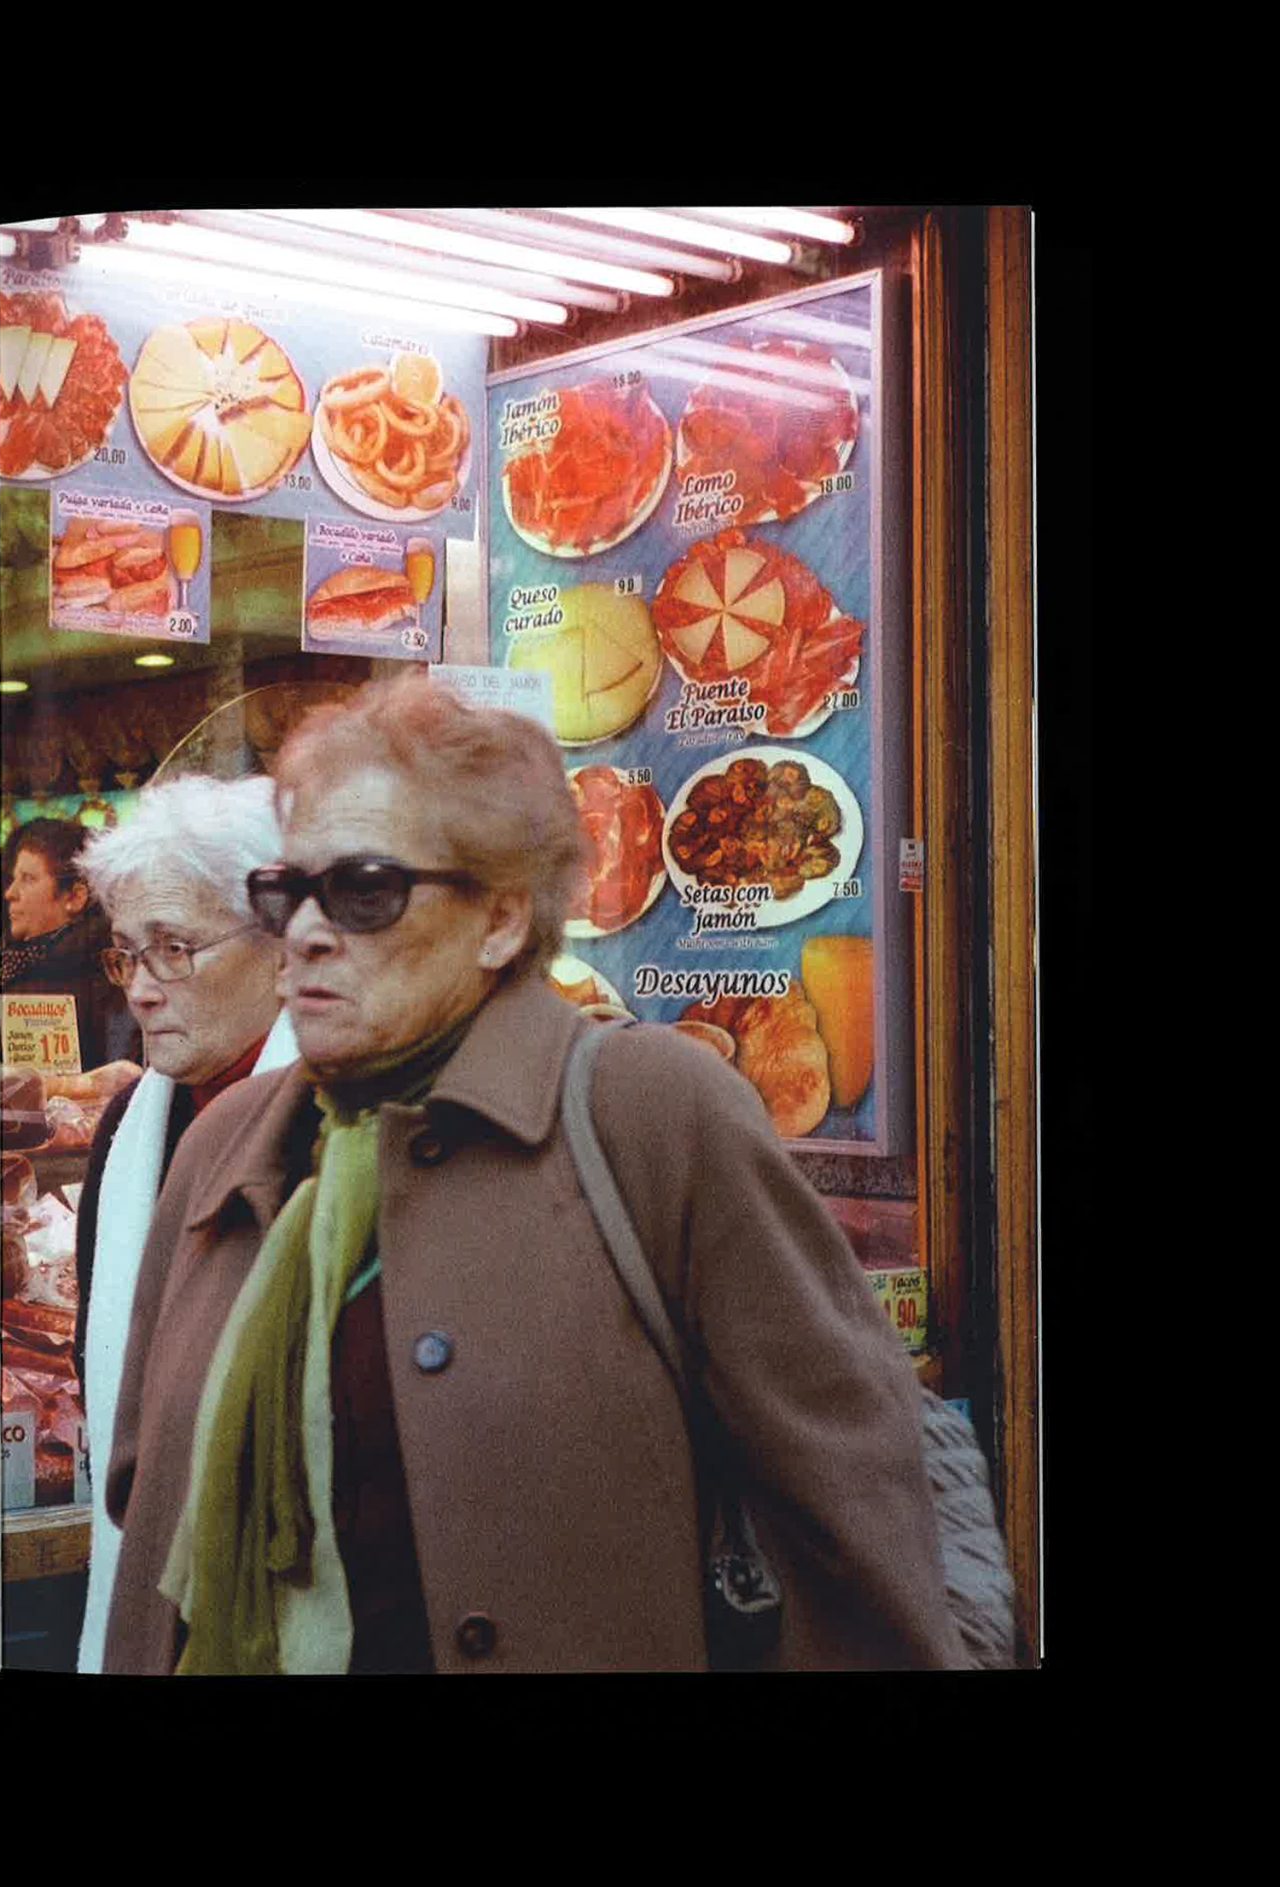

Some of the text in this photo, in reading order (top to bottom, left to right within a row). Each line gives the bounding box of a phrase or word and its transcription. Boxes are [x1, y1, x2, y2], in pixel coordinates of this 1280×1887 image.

[682, 472, 734, 497] Lomo
[675, 497, 742, 525] Ibérico
[510, 586, 557, 610] Queso
[505, 603, 563, 632] curado
[682, 678, 749, 707] Fuente
[667, 707, 687, 731] El
[682, 885, 770, 904] Setas con
[691, 907, 757, 936] jamón
[635, 967, 789, 1006] Desayunos
